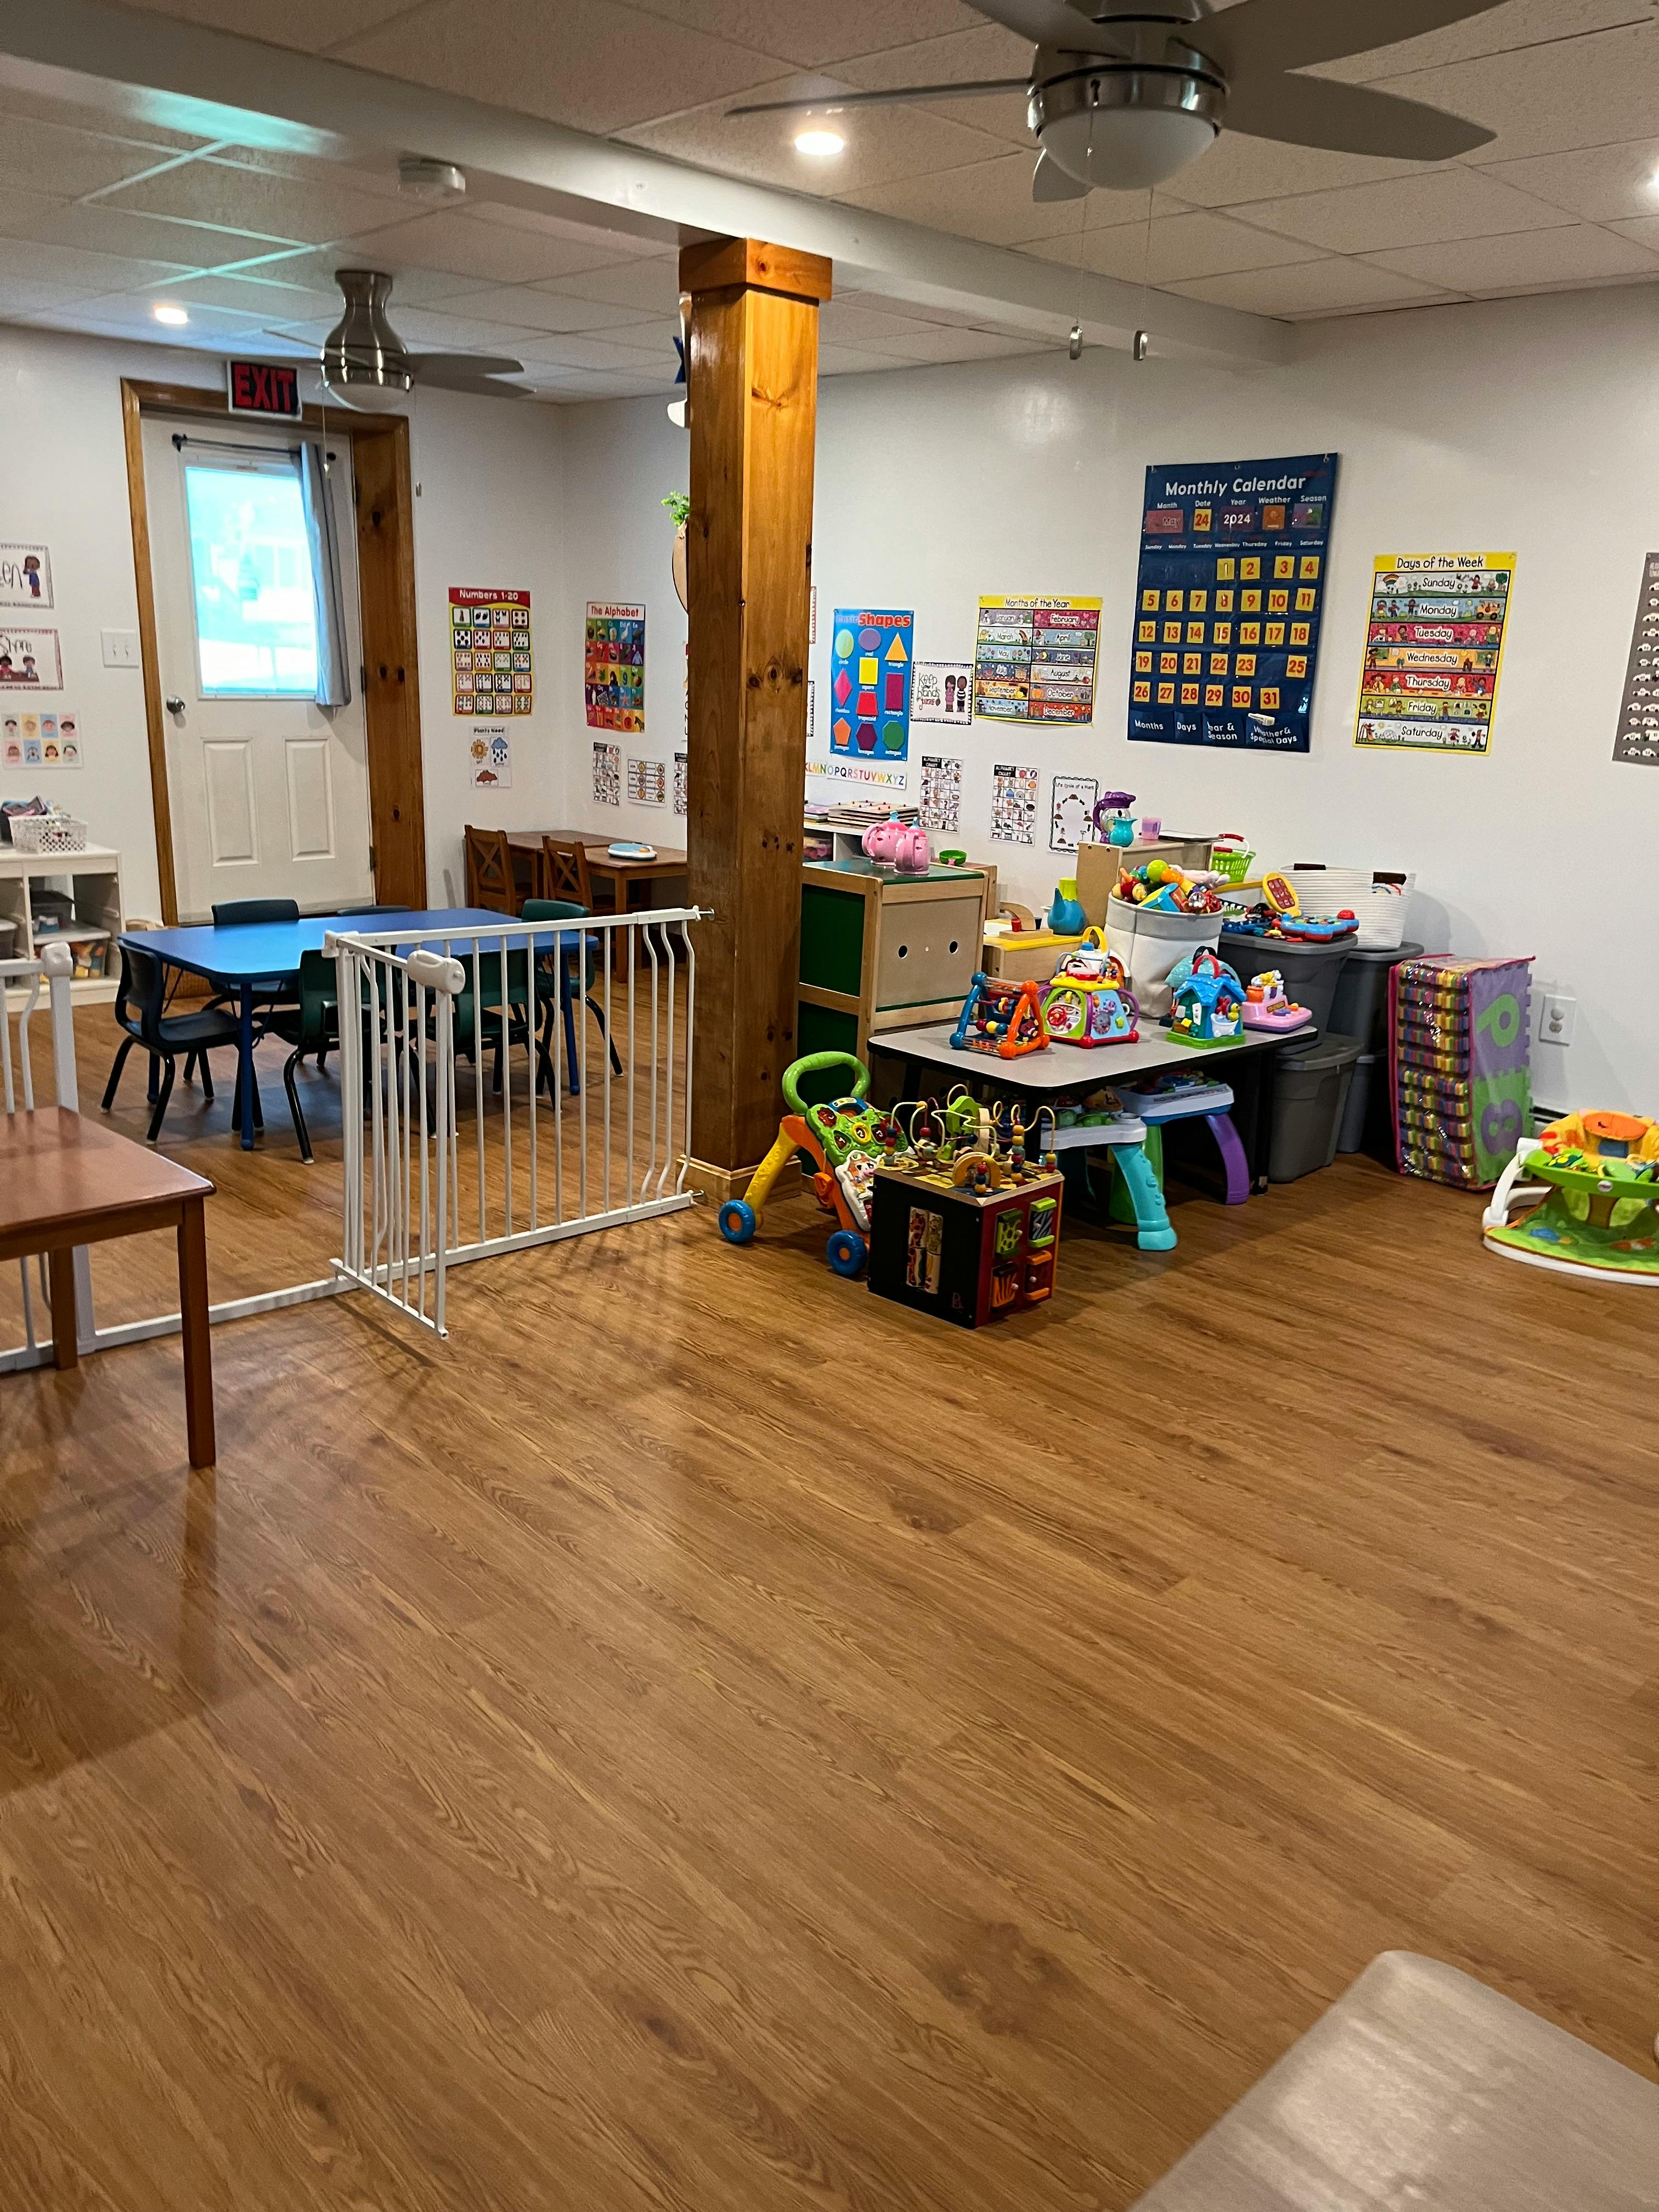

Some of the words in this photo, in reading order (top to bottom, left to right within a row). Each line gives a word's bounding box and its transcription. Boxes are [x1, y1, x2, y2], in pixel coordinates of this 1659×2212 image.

[234, 364, 294, 413] EXIT
[1165, 479, 1227, 496] Monthly
[1233, 475, 1306, 493] Calendar
[1195, 514, 1209, 526] 24
[1223, 515, 1251, 524] 2024
[1223, 563, 1229, 572] 1
[1246, 562, 1254, 575] 2
[1280, 561, 1288, 573] 3
[1305, 561, 1313, 574] 4
[1397, 557, 1420, 570] Days
[1423, 557, 1436, 568] of
[1438, 557, 1454, 568] the
[1458, 556, 1483, 567] Week
[1422, 578, 1455, 590] Sunday
[460, 590, 497, 600] Numbers
[1147, 594, 1155, 606] 5
[1171, 595, 1178, 606] 6
[1195, 595, 1202, 607] 7
[1220, 594, 1228, 607] 8
[1247, 594, 1255, 606] 9
[1272, 594, 1285, 607] 10
[1302, 593, 1311, 606] 11
[1005, 599, 1028, 607] Months
[1030, 598, 1038, 607] of
[1040, 599, 1051, 607] the
[1053, 599, 1070, 608] Year
[591, 606, 602, 615] The
[605, 606, 639, 618] Alphabet
[1420, 605, 1457, 617] Monday
[858, 612, 911, 629] Shapes
[1051, 615, 1079, 624] February
[1141, 627, 1153, 637] 12
[1167, 627, 1178, 639] 13
[1190, 628, 1202, 639] 14
[1216, 627, 1228, 640] 15
[1243, 628, 1257, 640] 16
[1269, 628, 1282, 640] 17
[1293, 628, 1306, 640] 18
[1415, 627, 1452, 640] Tuesday
[1138, 656, 1149, 667] 19
[1161, 657, 1176, 669] 20
[1187, 658, 1198, 670] 21
[1212, 659, 1226, 670] 22
[1238, 659, 1253, 672] 23
[1288, 661, 1304, 673] 25
[1407, 653, 1457, 664] Wednesday
[1051, 669, 1070, 679] August
[1407, 676, 1451, 690] Thursday
[989, 685, 1015, 695] September
[1047, 689, 1074, 698] October
[1135, 686, 1148, 698] 26
[1160, 688, 1172, 699] 27
[1183, 689, 1197, 700] 28
[1207, 690, 1221, 702] 29
[1233, 691, 1250, 703] 30
[1263, 692, 1277, 704] 31
[1044, 707, 1074, 716] December
[1408, 702, 1436, 715] Friday
[1135, 720, 1163, 730] Months
[1177, 722, 1196, 731] Days
[1208, 731, 1237, 740] Season
[1401, 726, 1443, 739] Saturday
[1276, 735, 1297, 744] Days
